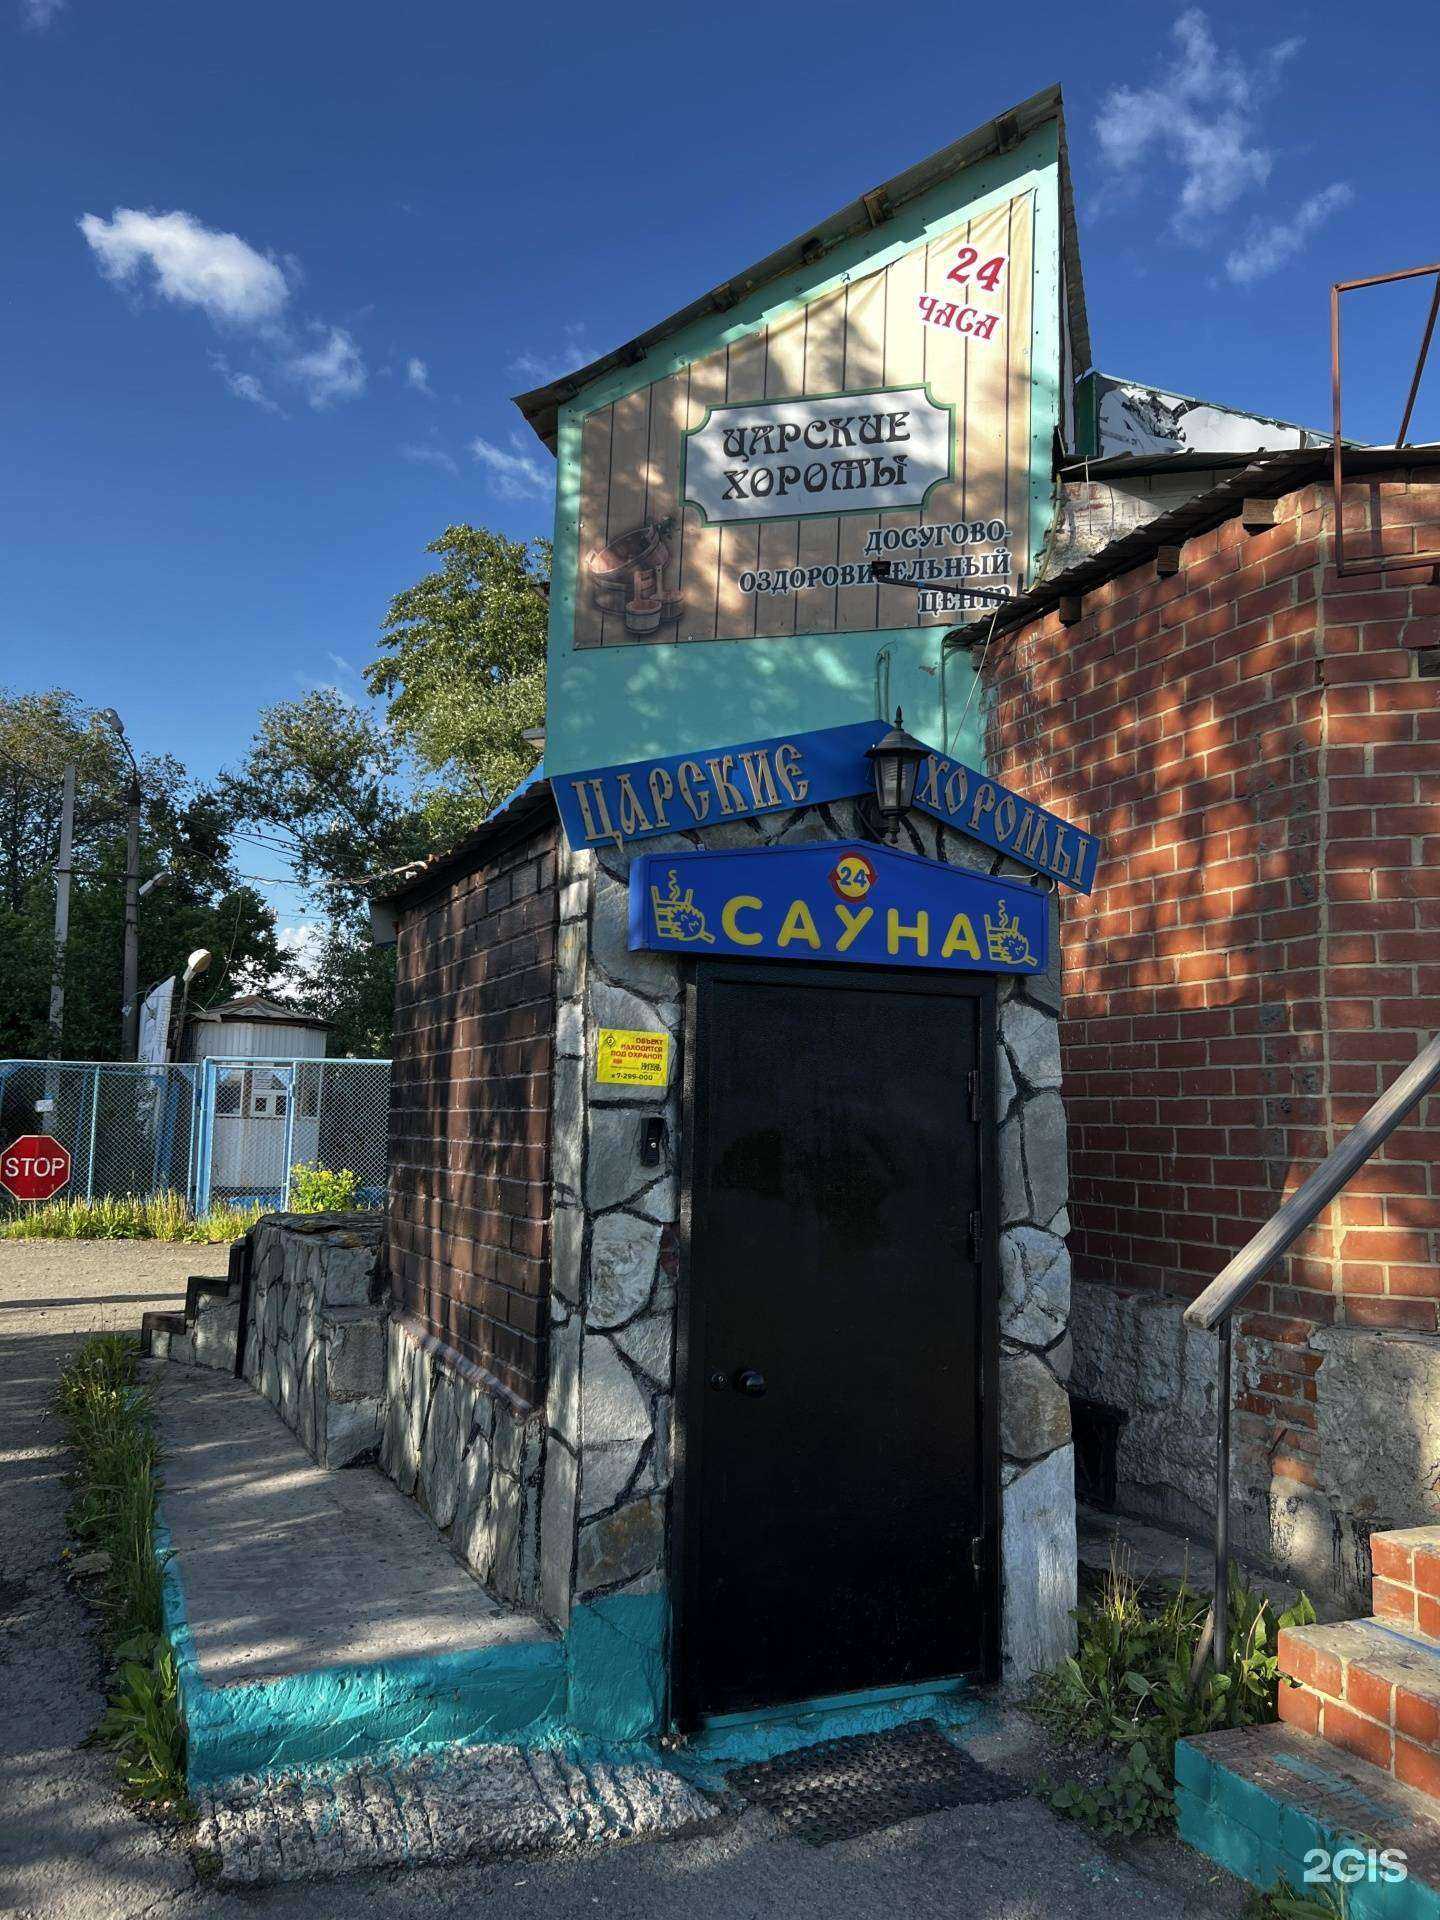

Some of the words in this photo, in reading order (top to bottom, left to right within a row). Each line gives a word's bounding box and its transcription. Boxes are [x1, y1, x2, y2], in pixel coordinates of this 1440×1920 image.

[947, 248, 1005, 291] 24
[919, 297, 999, 339] ЧАСА
[722, 411, 911, 462] ЦАРСКИЕ
[722, 455, 908, 500] ХОРОМЫ
[865, 520, 1011, 553] ДОСУГОВО-
[739, 549, 1010, 594] ОЗДОРОВИЕЛЬНЫЙ
[571, 744, 808, 853] ЦАРСКИЕ
[916, 754, 1089, 886] ХОРОМЫ
[840, 866, 867, 889] 24
[721, 895, 982, 960] САУНА
[610, 1050, 627, 1058] ПОД
[5, 1157, 65, 1177] STOP
